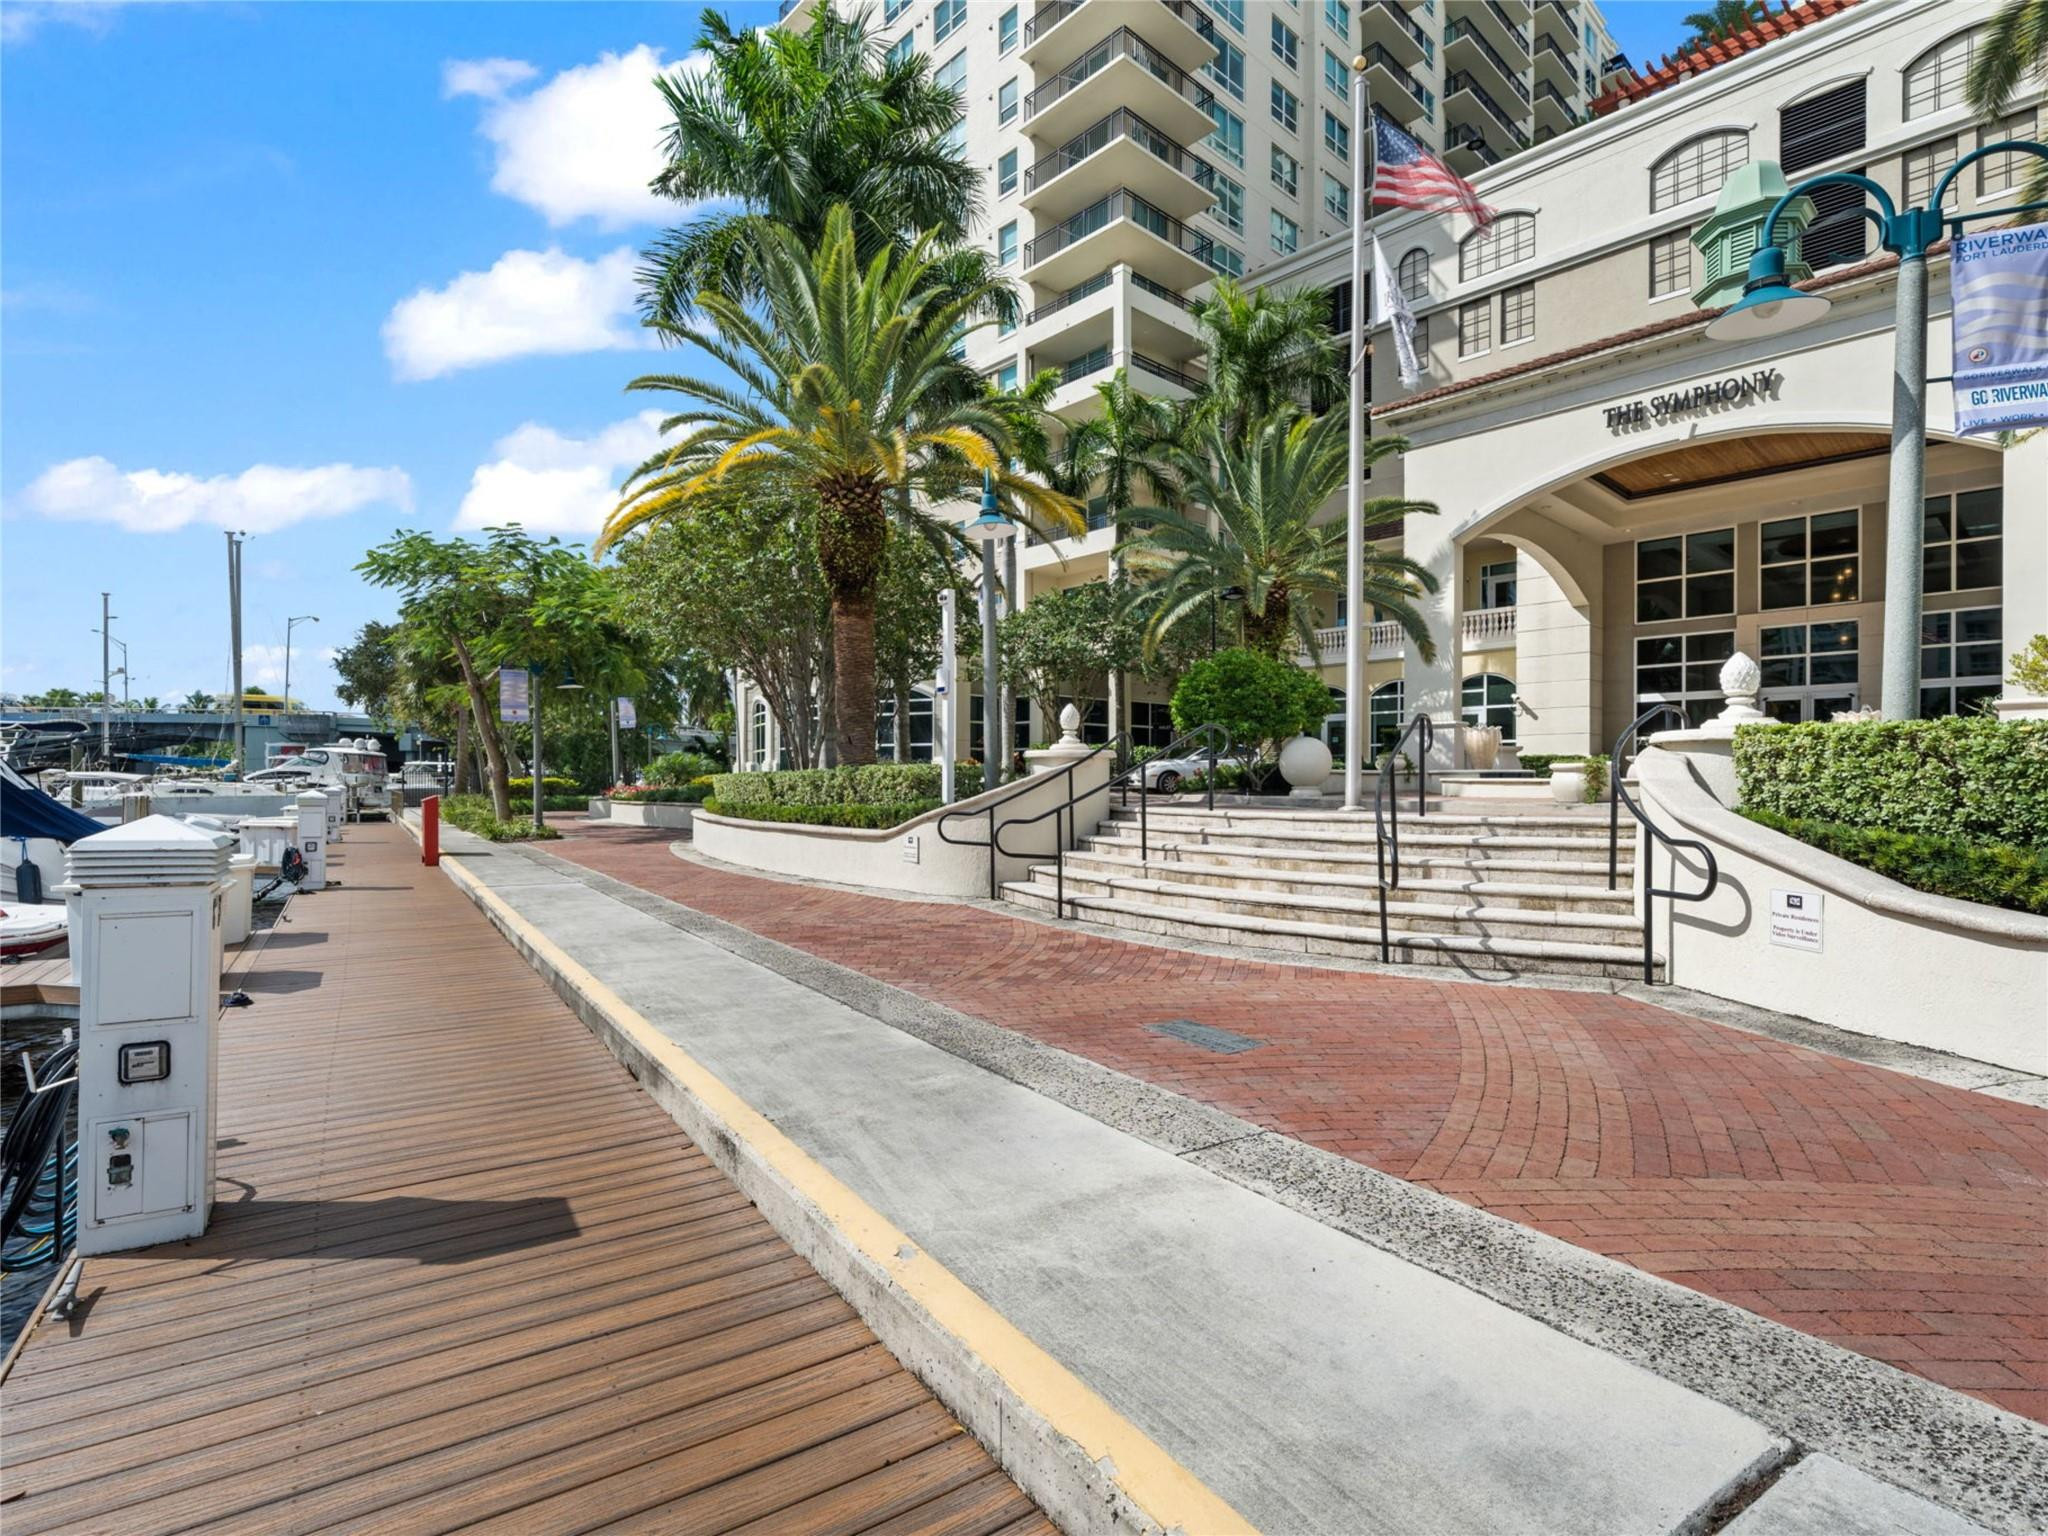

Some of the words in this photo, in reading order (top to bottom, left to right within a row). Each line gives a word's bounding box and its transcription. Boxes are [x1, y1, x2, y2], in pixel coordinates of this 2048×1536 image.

[1955, 250, 1987, 264] FORT
[1602, 401, 1644, 428] THE
[1650, 368, 1776, 418] SYMPHONY
[1991, 382, 2048, 404] RIVERWA
[2000, 412, 2034, 423] WORK
